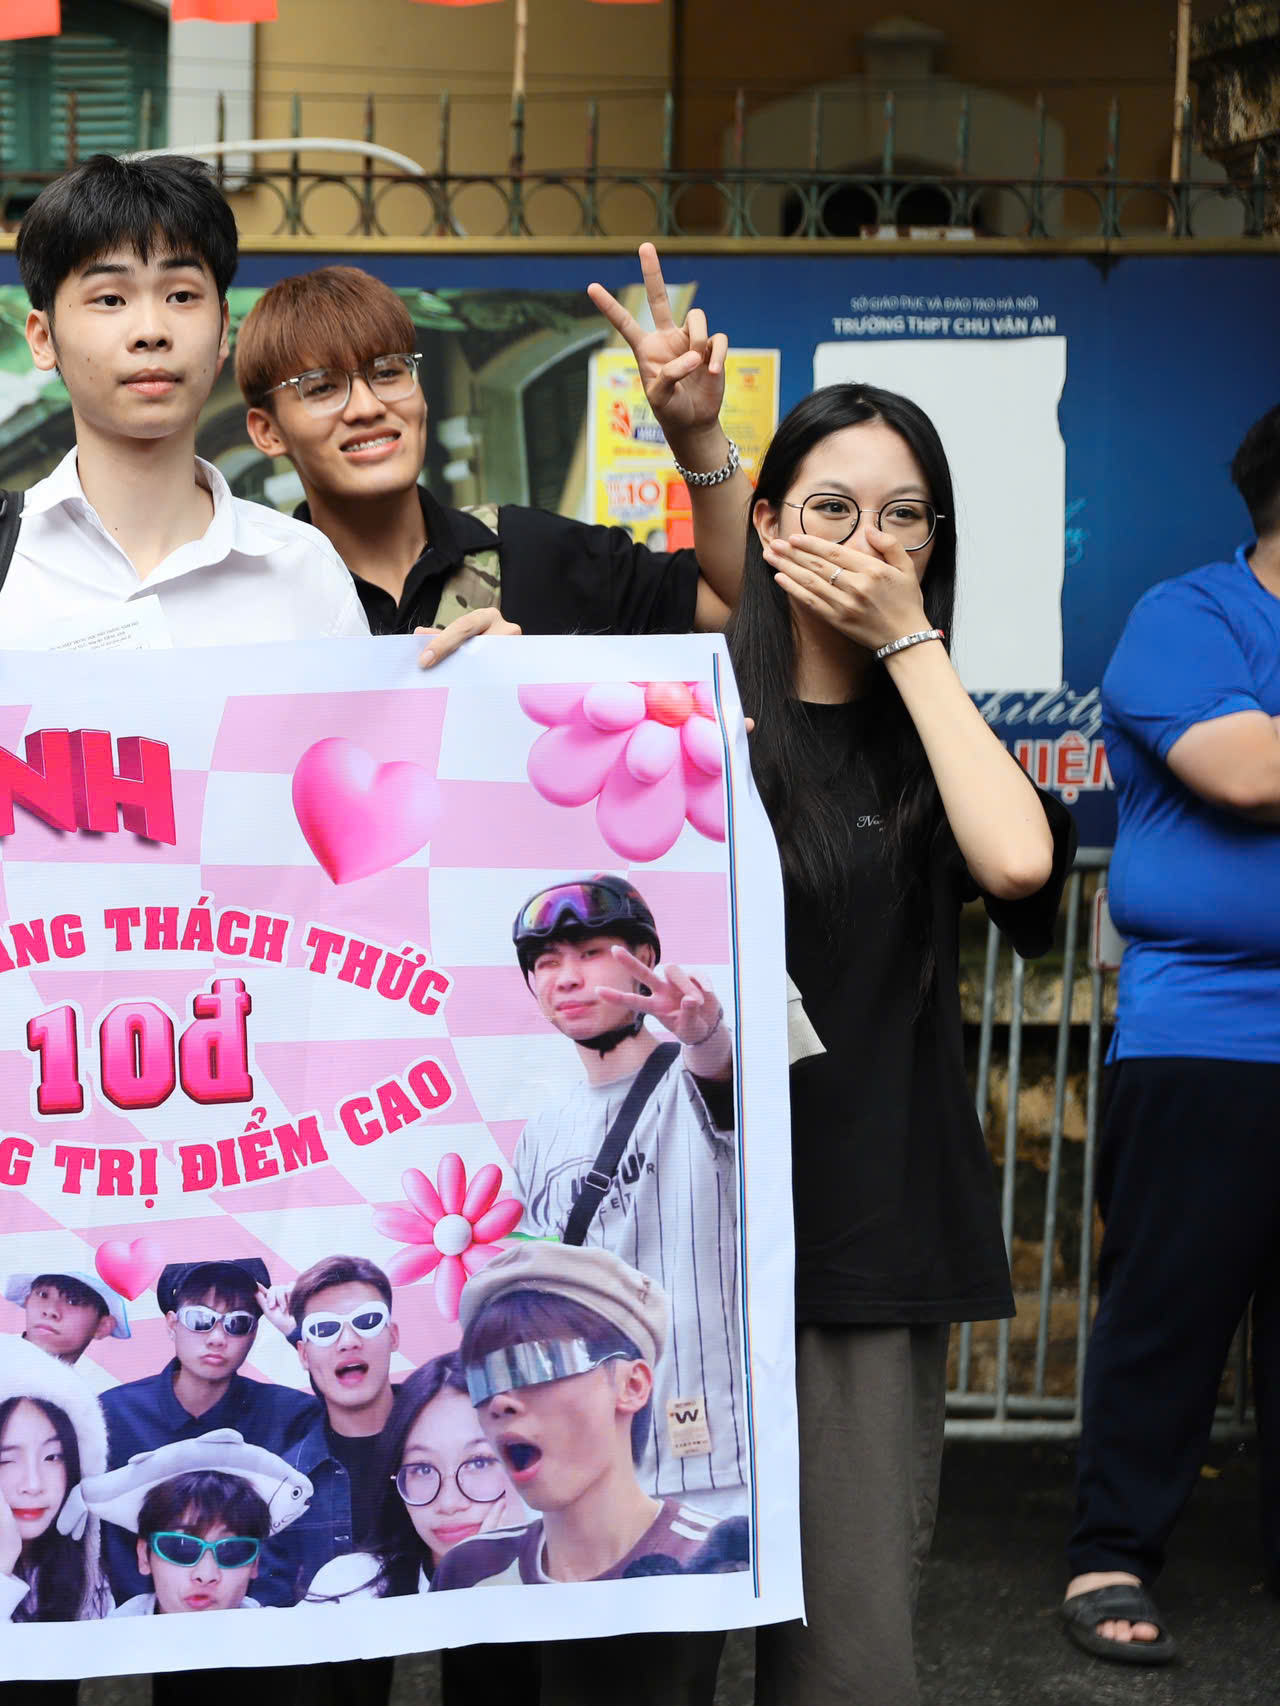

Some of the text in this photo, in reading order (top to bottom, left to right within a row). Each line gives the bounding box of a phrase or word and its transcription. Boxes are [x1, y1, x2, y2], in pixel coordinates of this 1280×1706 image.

[907, 316, 951, 335] THPT
[953, 318, 990, 334] CHU
[992, 315, 1028, 334] VĂN
[1030, 315, 1057, 333] AN
[104, 896, 289, 963] THÁCH
[305, 926, 450, 1016] THỨC
[26, 978, 254, 1115] 10đ
[53, 1144, 159, 1209] TRỊ
[178, 1107, 328, 1193] ĐIỂM
[339, 1060, 453, 1147] CAO
